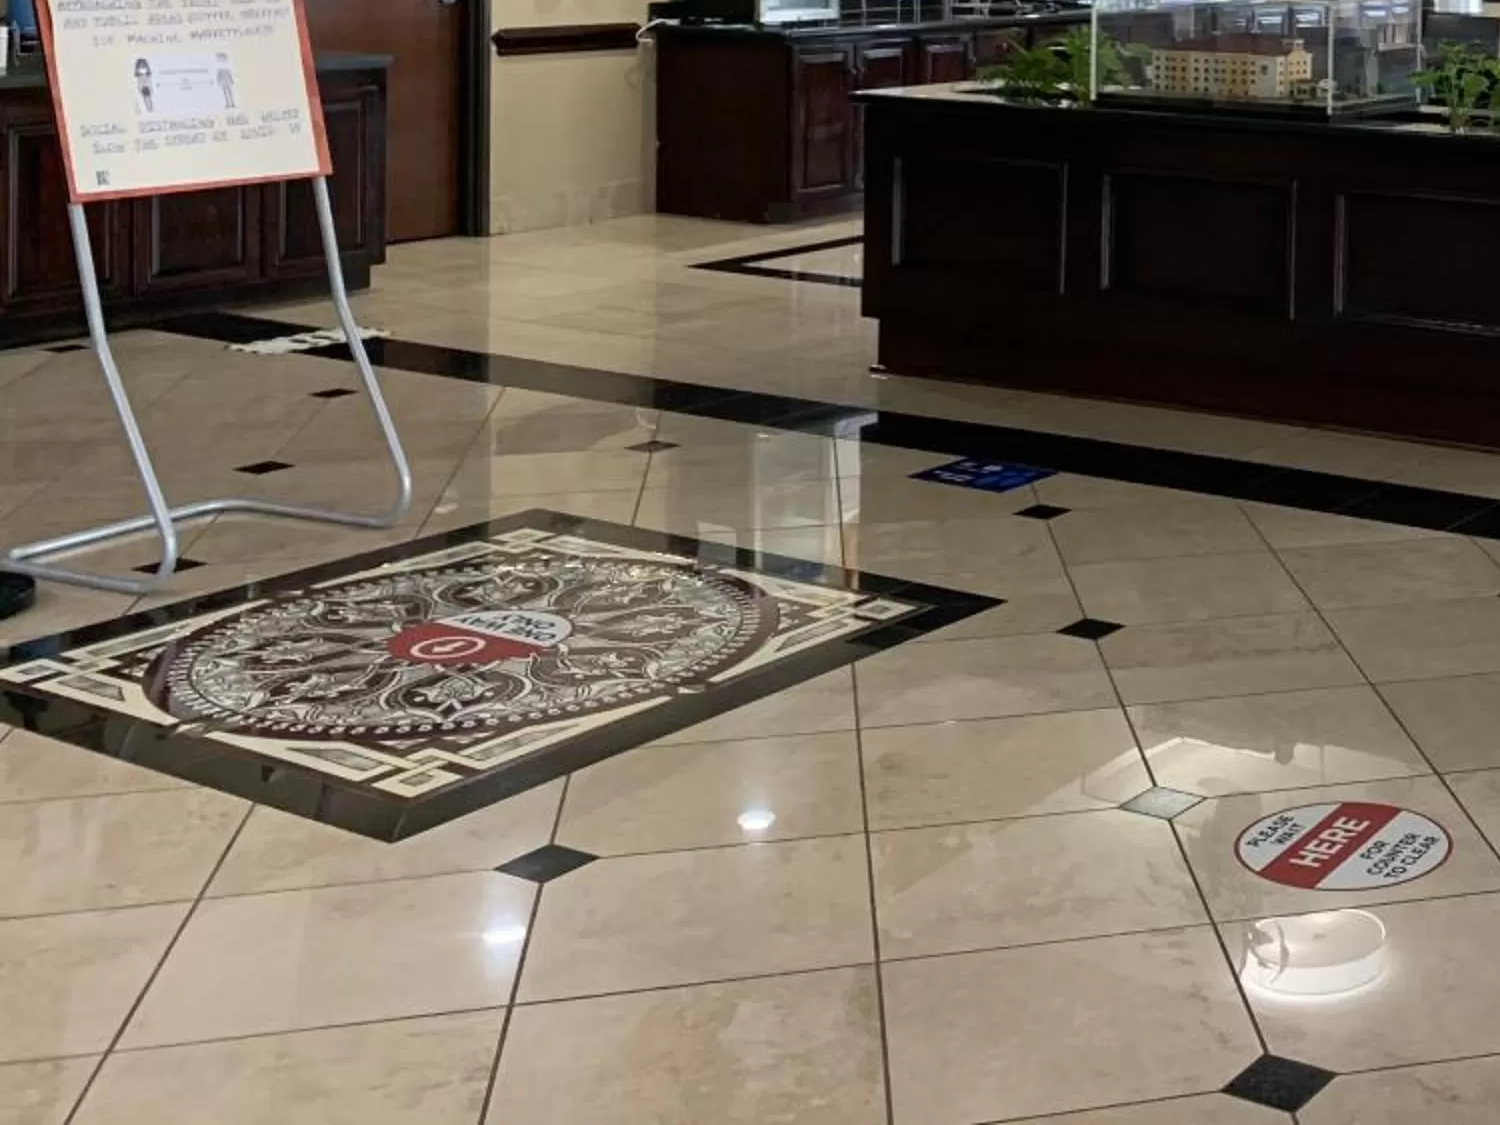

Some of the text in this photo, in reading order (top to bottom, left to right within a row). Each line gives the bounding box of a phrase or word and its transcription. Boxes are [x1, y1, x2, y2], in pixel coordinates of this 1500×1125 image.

[1246, 814, 1295, 847] PLEASE
[1270, 823, 1304, 845] WAIT
[1289, 816, 1372, 868] HERE
[1359, 840, 1392, 860] FOR
[1366, 832, 1422, 875] COUNTER
[1383, 836, 1441, 878] TO CLEAR
